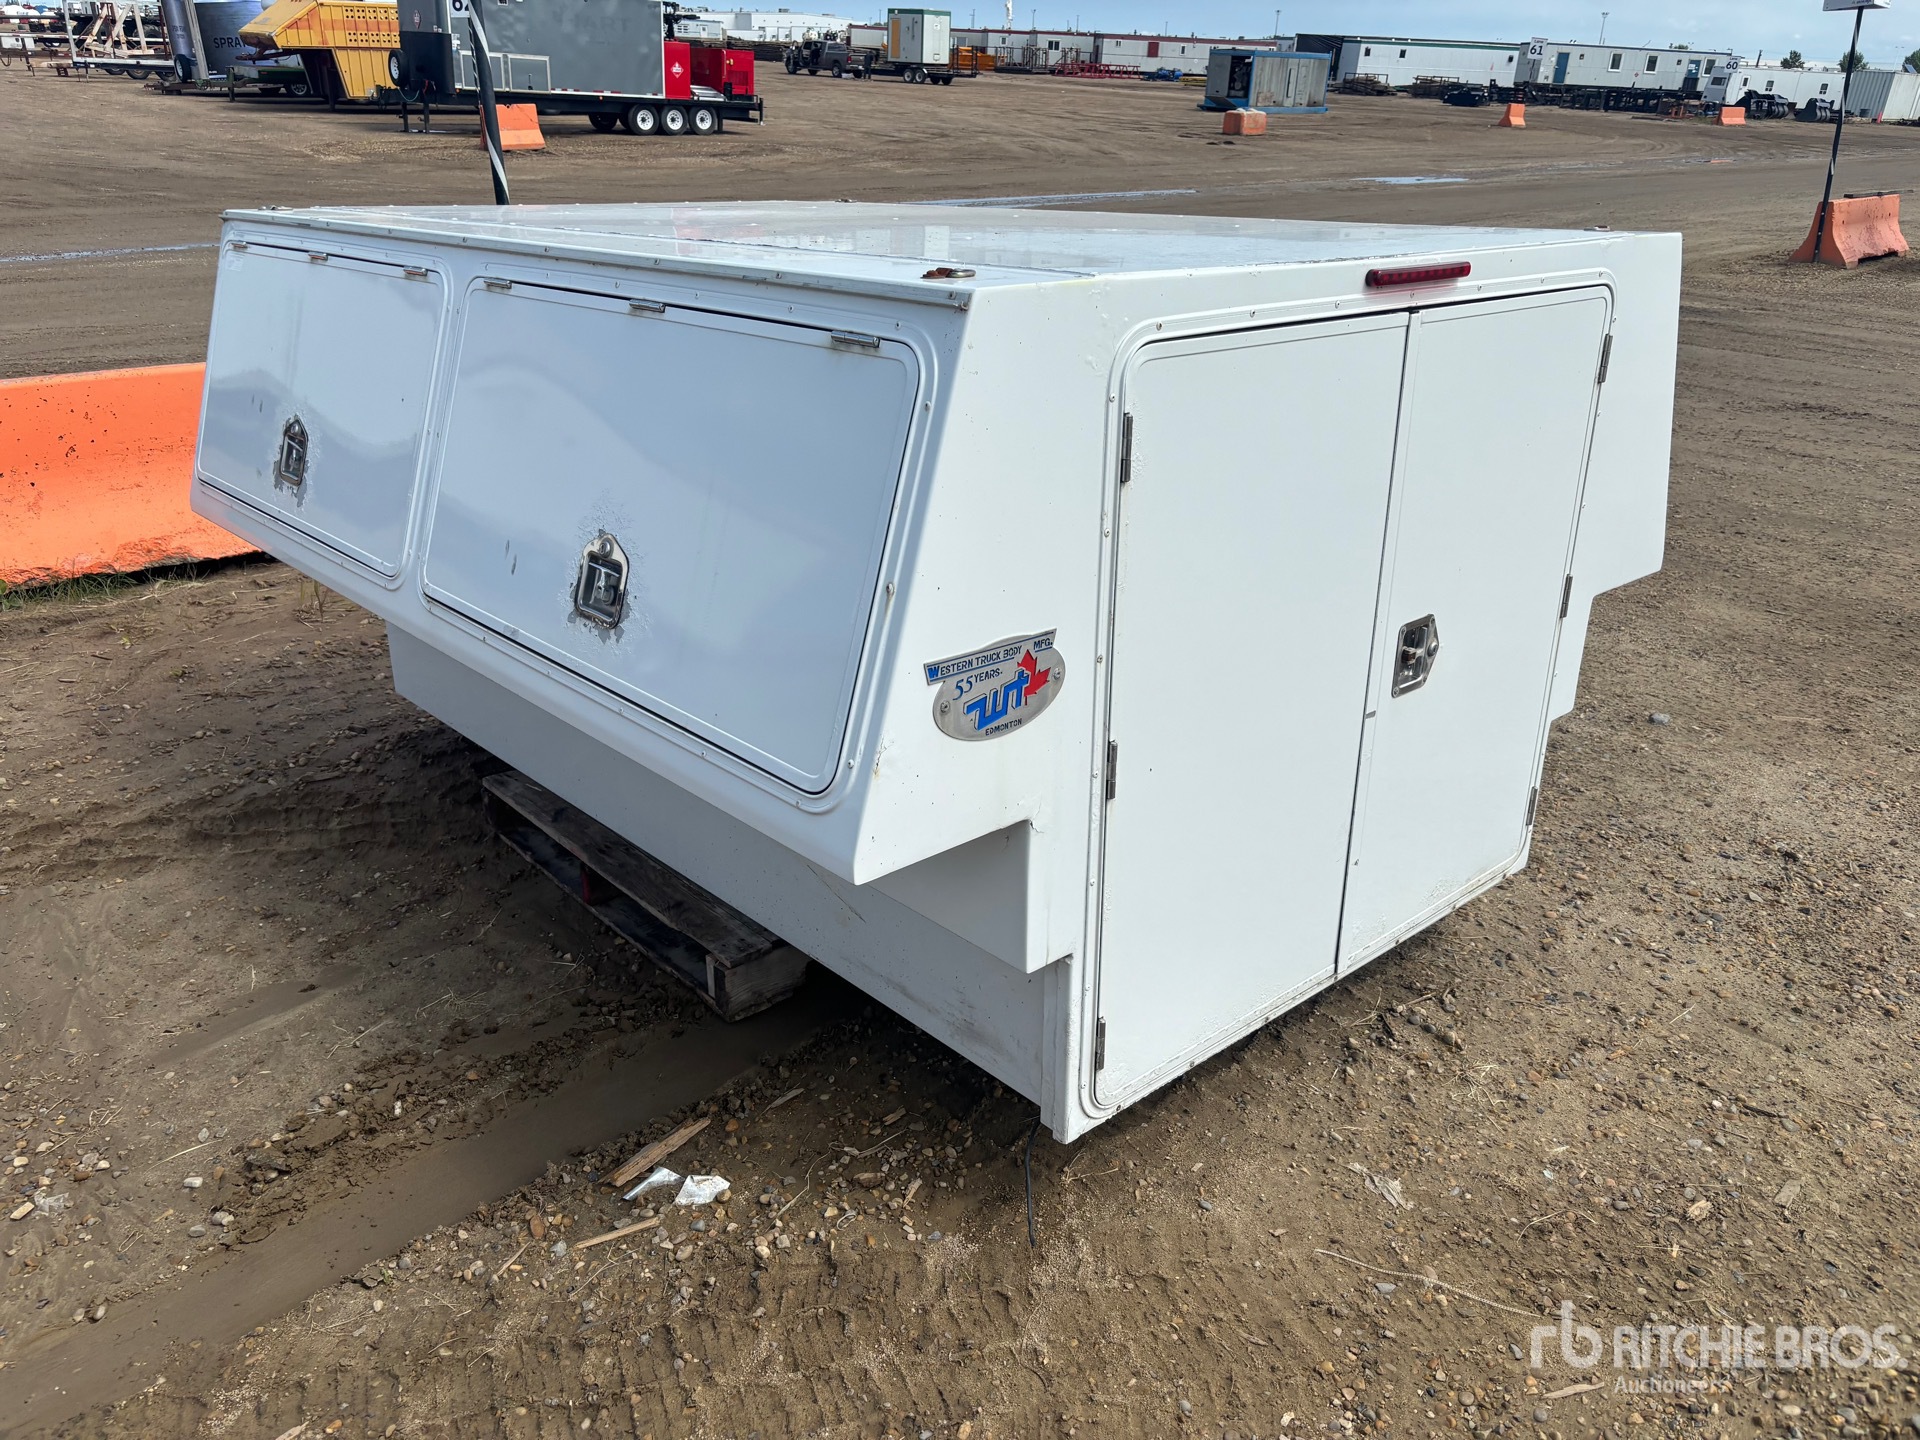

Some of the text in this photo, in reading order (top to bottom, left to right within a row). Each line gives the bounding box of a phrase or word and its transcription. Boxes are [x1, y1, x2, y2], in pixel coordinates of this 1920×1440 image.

[1530, 45, 1543, 55] 61
[1726, 61, 1739, 70] 60
[927, 638, 1053, 679] WESTERN TRUCK BODY MFG.
[952, 675, 973, 701] 55
[985, 718, 1023, 736] EDMONTON
